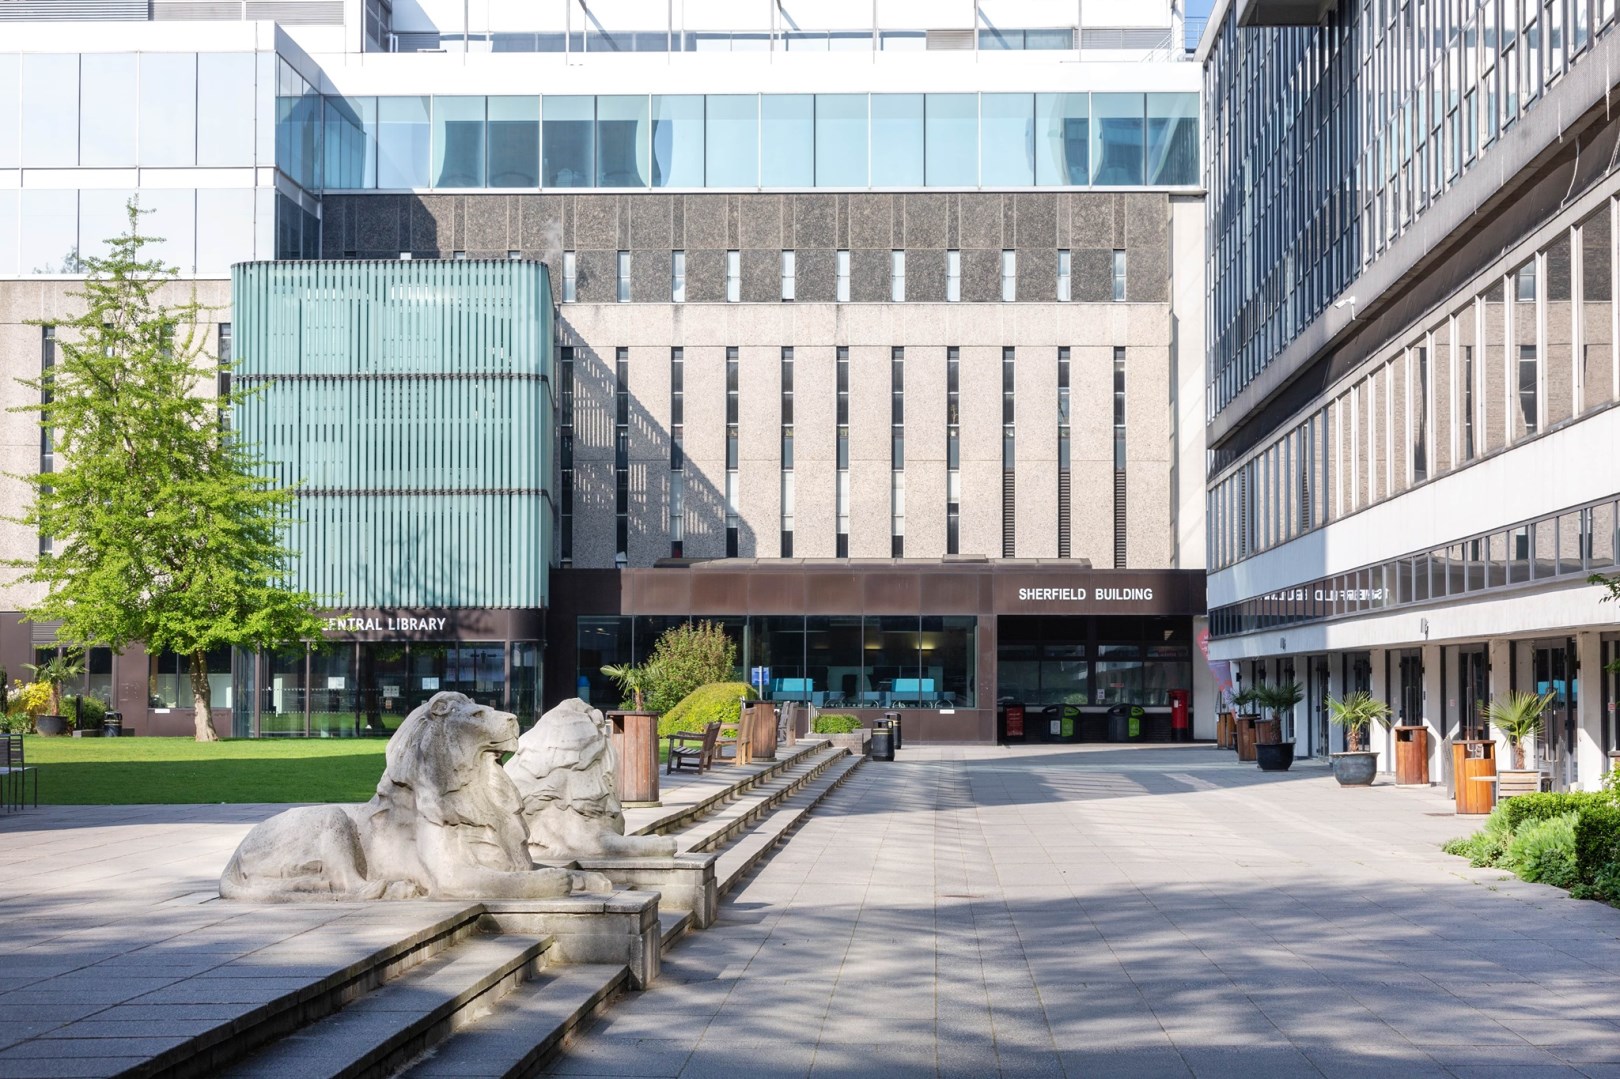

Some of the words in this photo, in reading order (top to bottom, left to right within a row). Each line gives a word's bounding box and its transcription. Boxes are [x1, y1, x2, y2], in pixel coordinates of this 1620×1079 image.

[1018, 588, 1087, 600] SHERFIELD
[1095, 588, 1153, 600] BUILDING
[388, 617, 446, 631] LIBRARY
